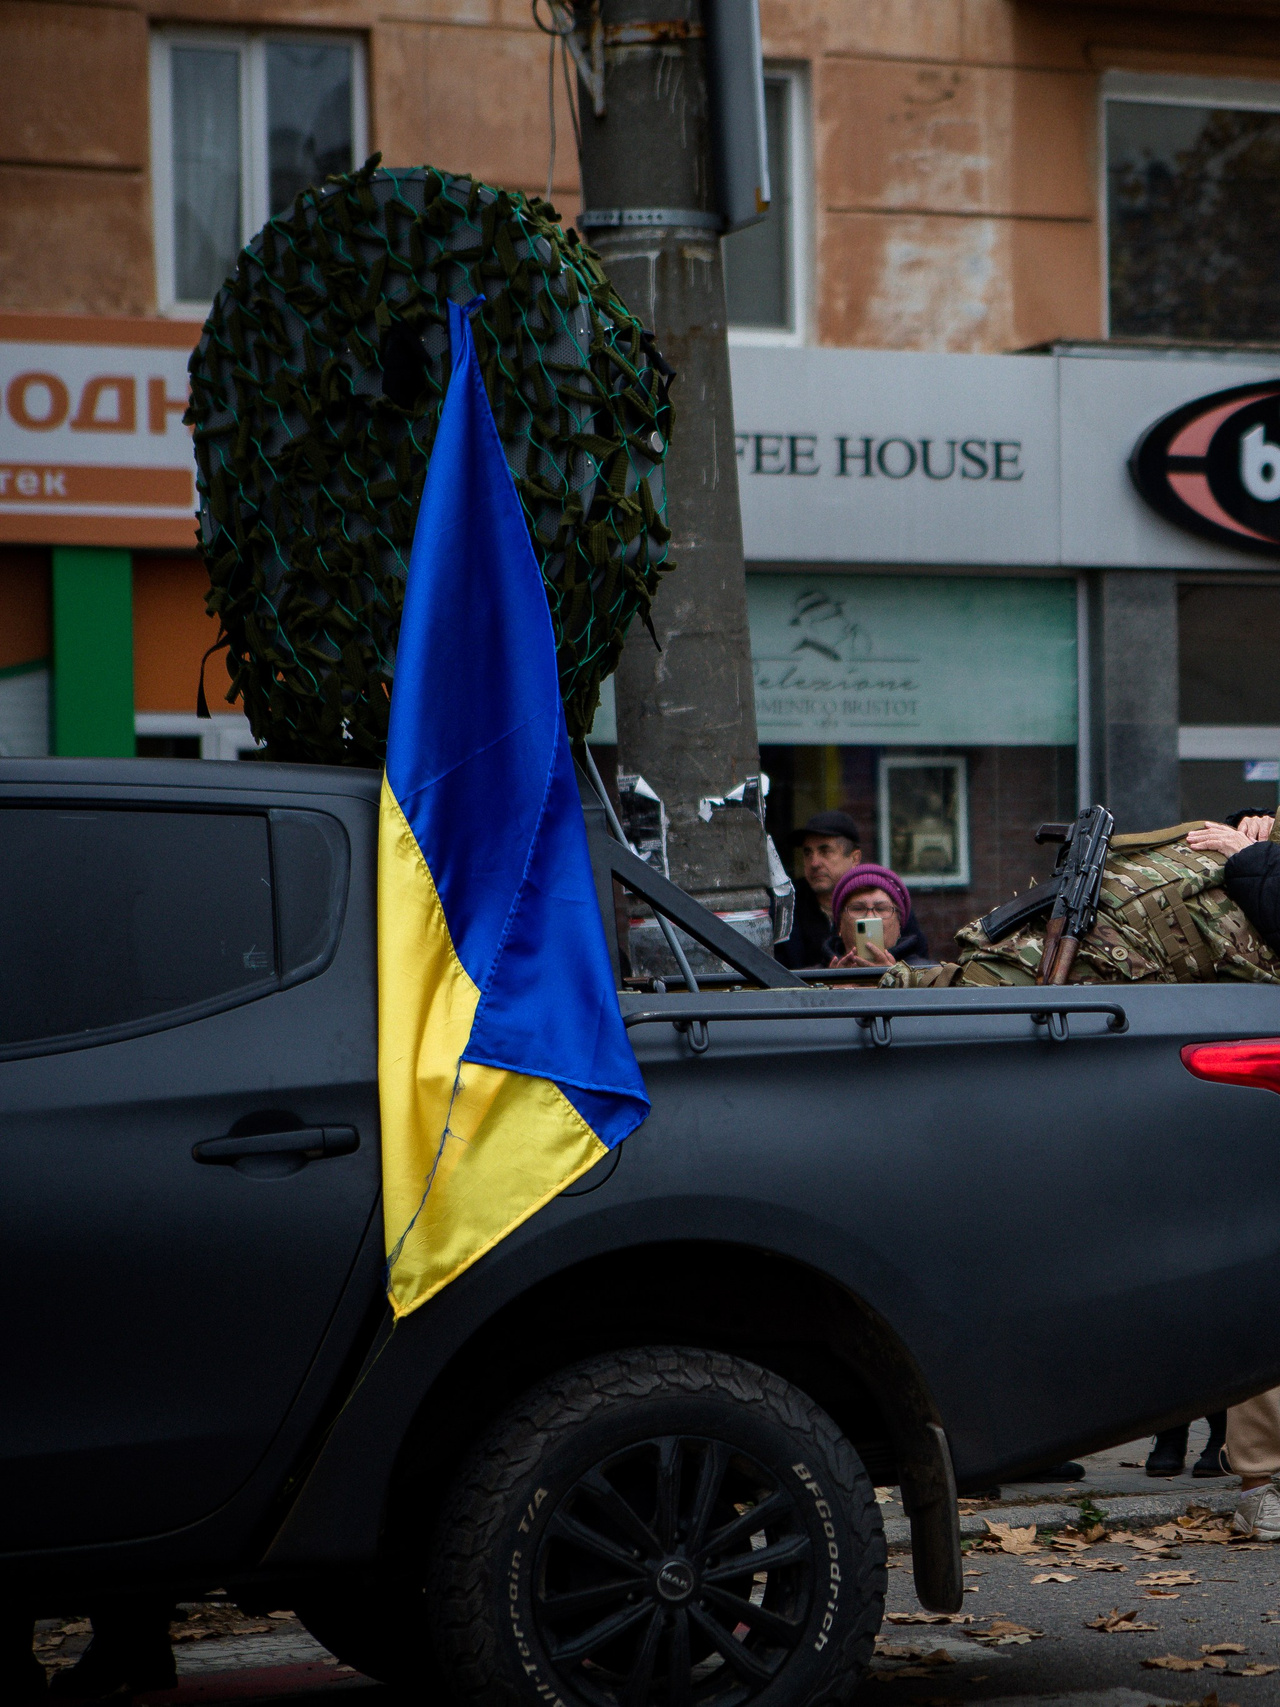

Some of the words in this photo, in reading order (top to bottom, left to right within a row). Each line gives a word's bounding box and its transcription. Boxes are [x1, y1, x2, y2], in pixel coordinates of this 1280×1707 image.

[834, 435, 1025, 481] HOUSE
[753, 662, 919, 692] elezione
[842, 699, 918, 716] BRISTOT
[518, 1487, 549, 1535] T/A
[791, 1462, 842, 1653] BFGoodrich
[661, 1570, 688, 1590] MAK
